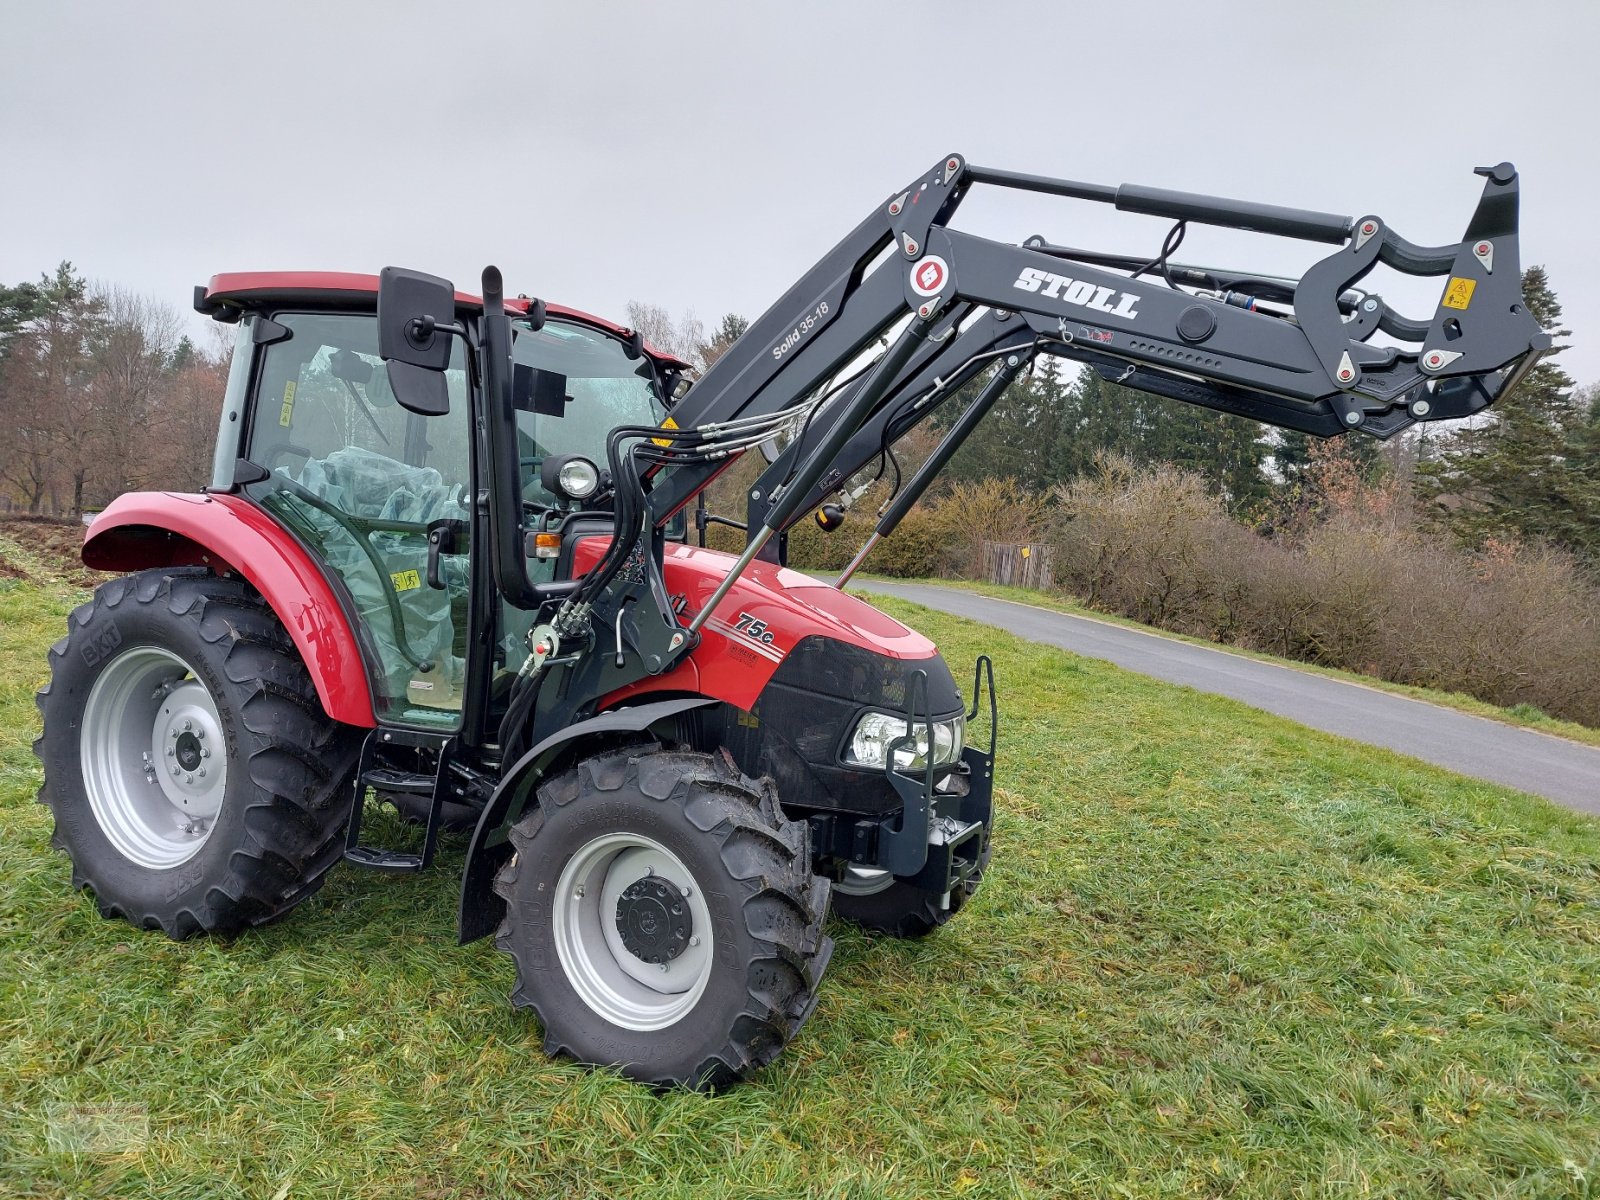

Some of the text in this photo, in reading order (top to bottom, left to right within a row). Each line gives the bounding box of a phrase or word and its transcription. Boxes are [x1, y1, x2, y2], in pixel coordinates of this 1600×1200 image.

[1013, 267, 1141, 319] STOLL
[773, 302, 829, 360] Solid 35-18
[82, 618, 122, 668] BKT
